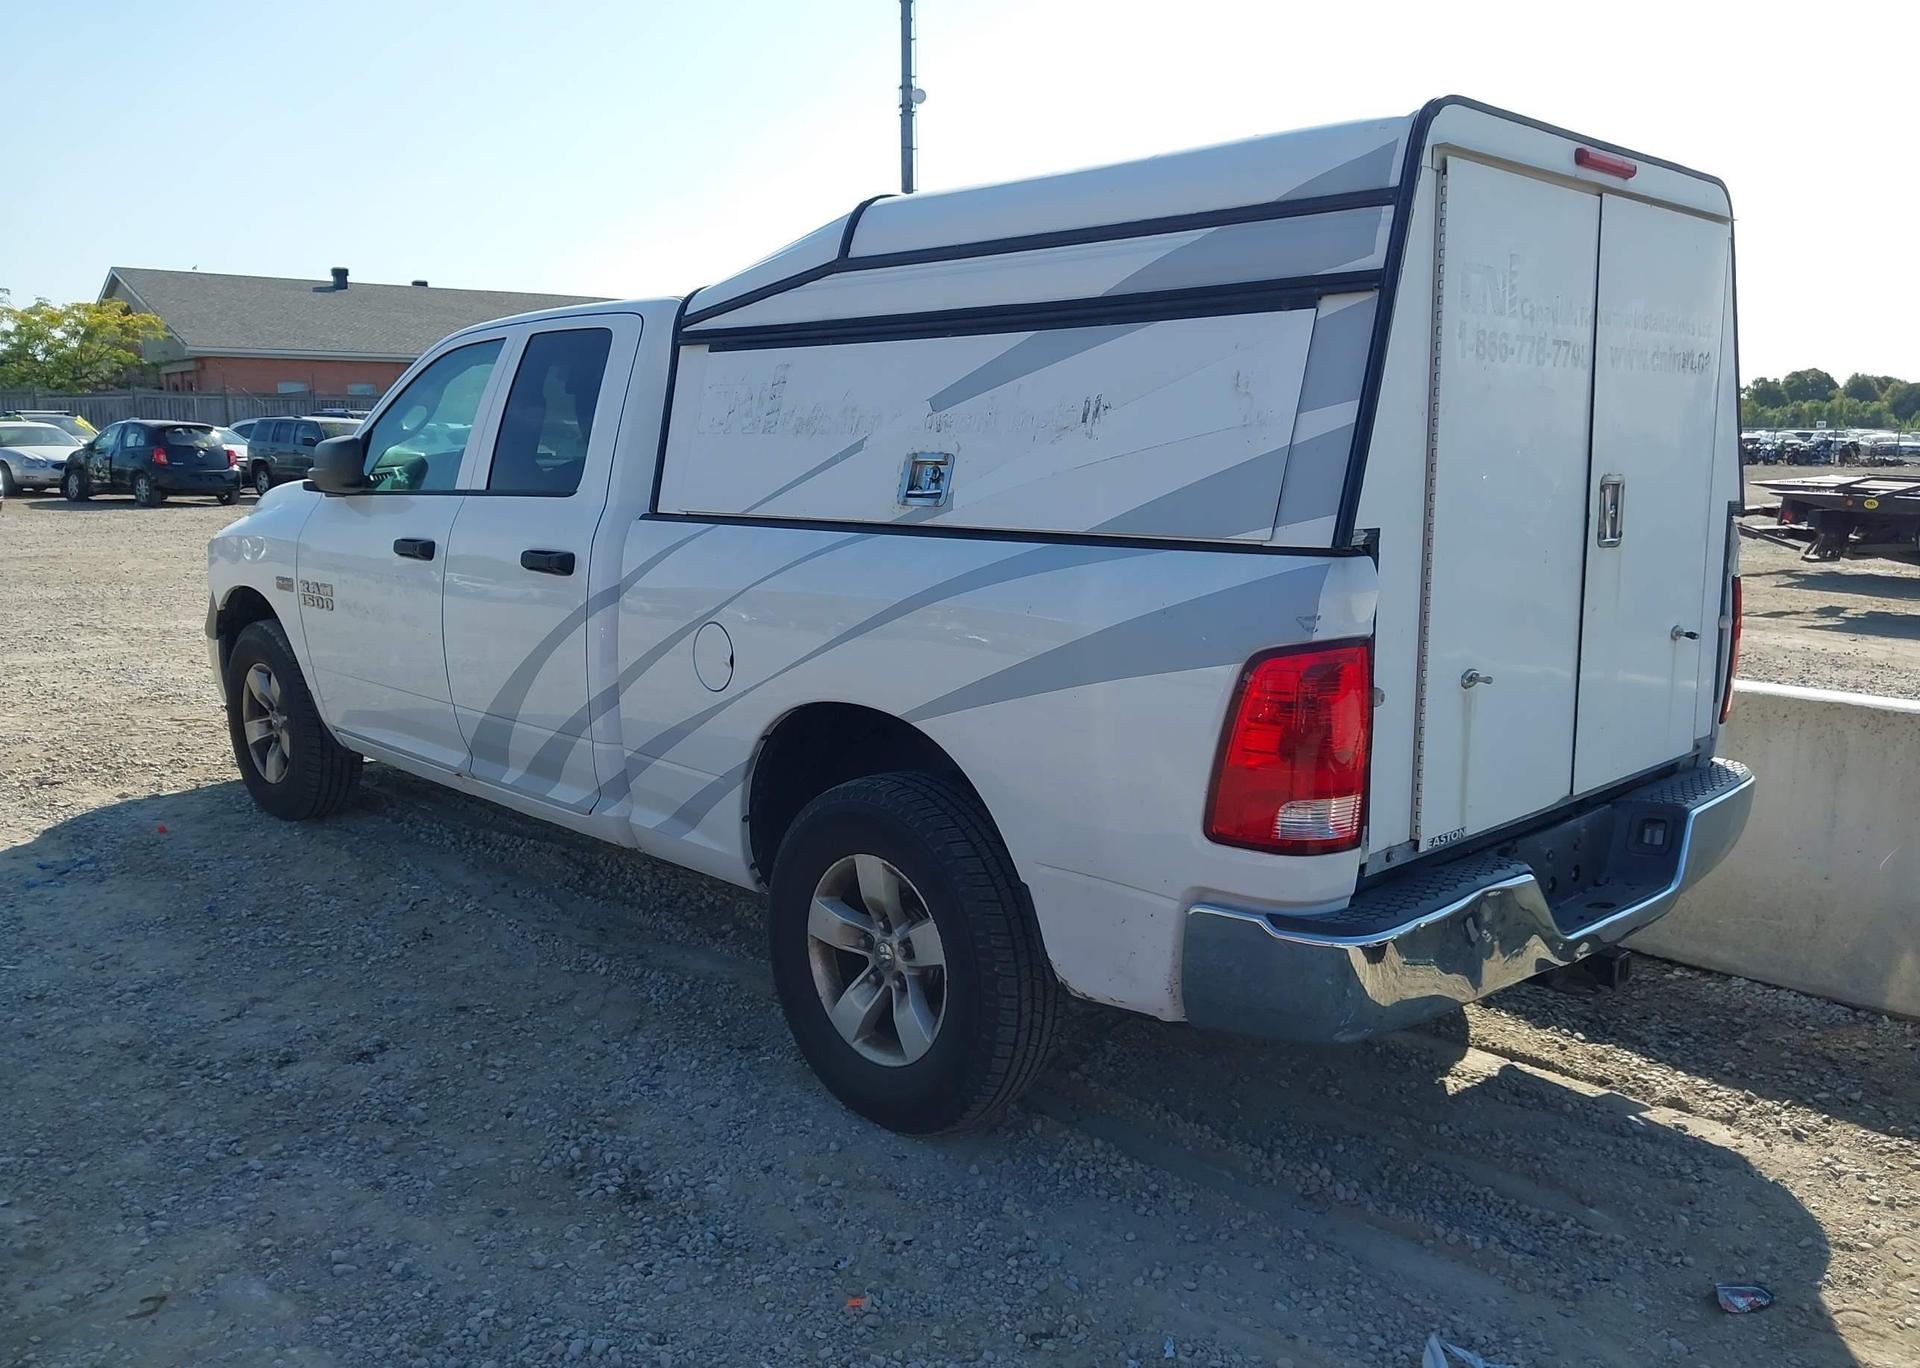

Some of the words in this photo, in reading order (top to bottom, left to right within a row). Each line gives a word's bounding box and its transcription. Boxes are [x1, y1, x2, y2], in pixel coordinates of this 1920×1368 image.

[300, 580, 334, 598] RAM
[301, 593, 335, 612] 1500
[1427, 826, 1466, 849] EASTON
